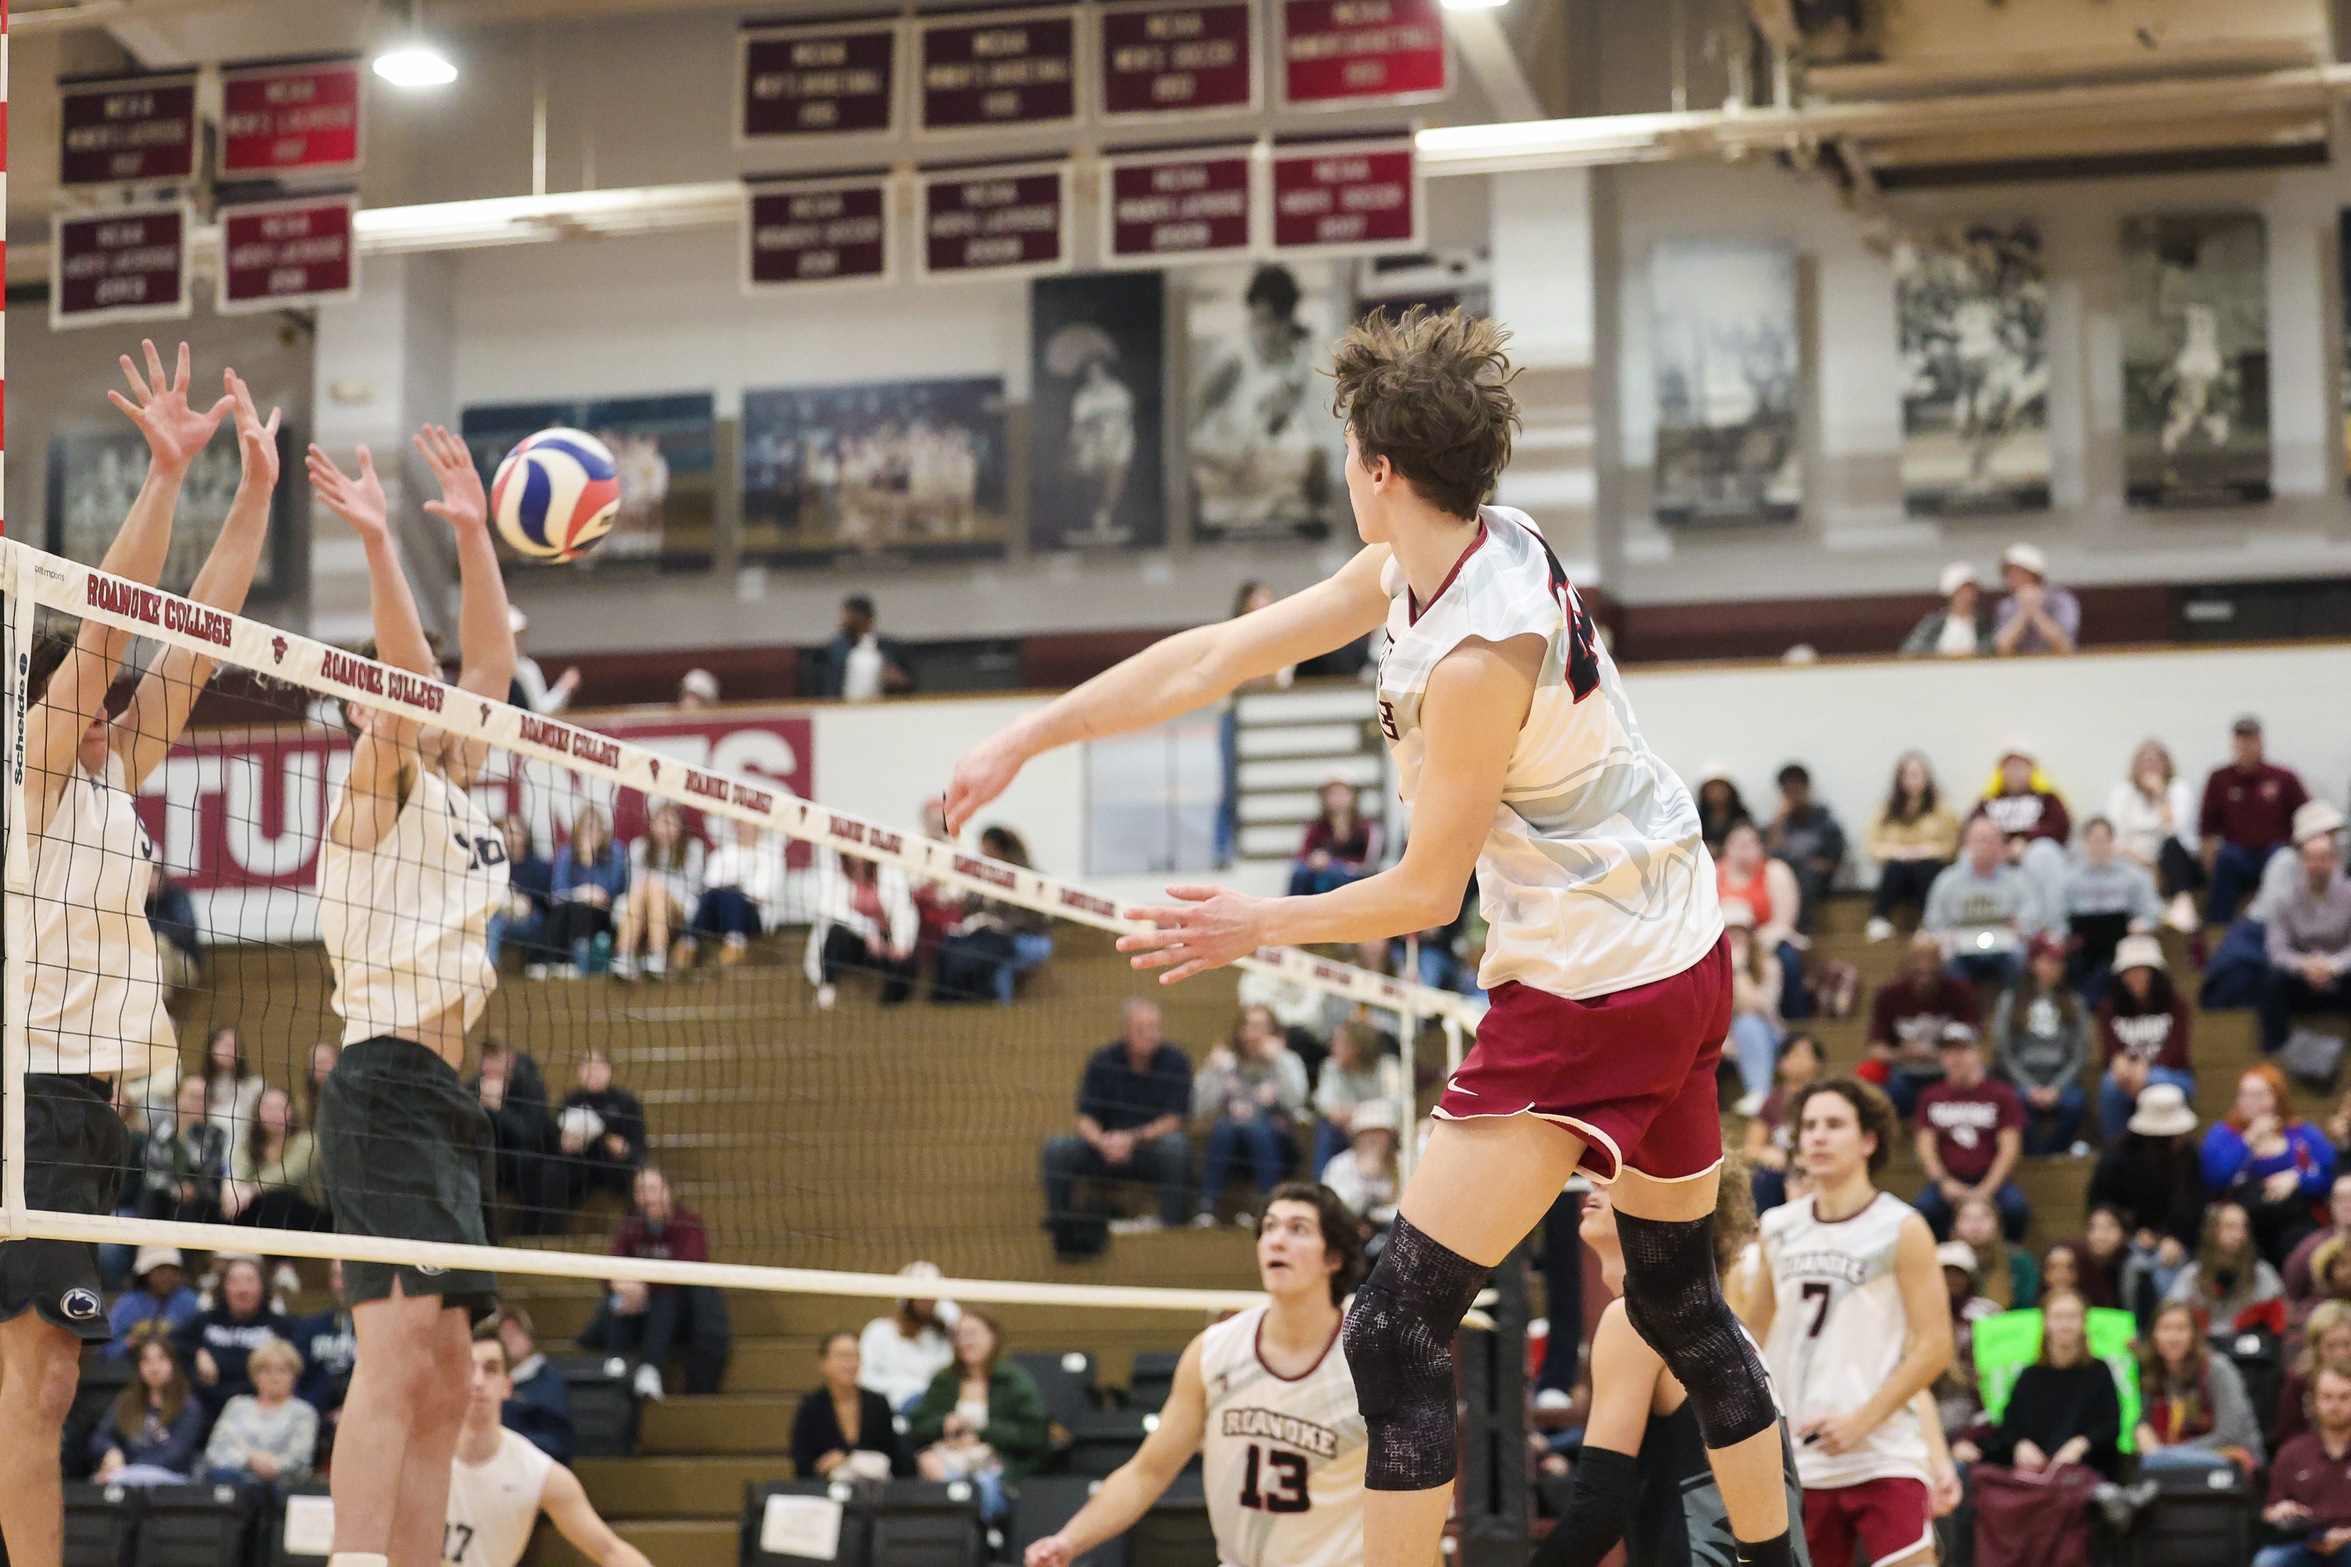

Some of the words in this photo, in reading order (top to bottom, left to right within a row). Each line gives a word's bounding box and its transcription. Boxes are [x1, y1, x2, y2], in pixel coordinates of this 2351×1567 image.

[87, 573, 162, 626] ROANOKE
[164, 598, 233, 648] COLLEGE
[321, 650, 383, 697] ROANOKE
[388, 672, 445, 714] COLLEGE
[14, 679, 25, 786] Schelde
[1802, 1282, 1830, 1339] 7
[1222, 1407, 1339, 1460] ROANOKE
[1240, 1443, 1312, 1513] 13
